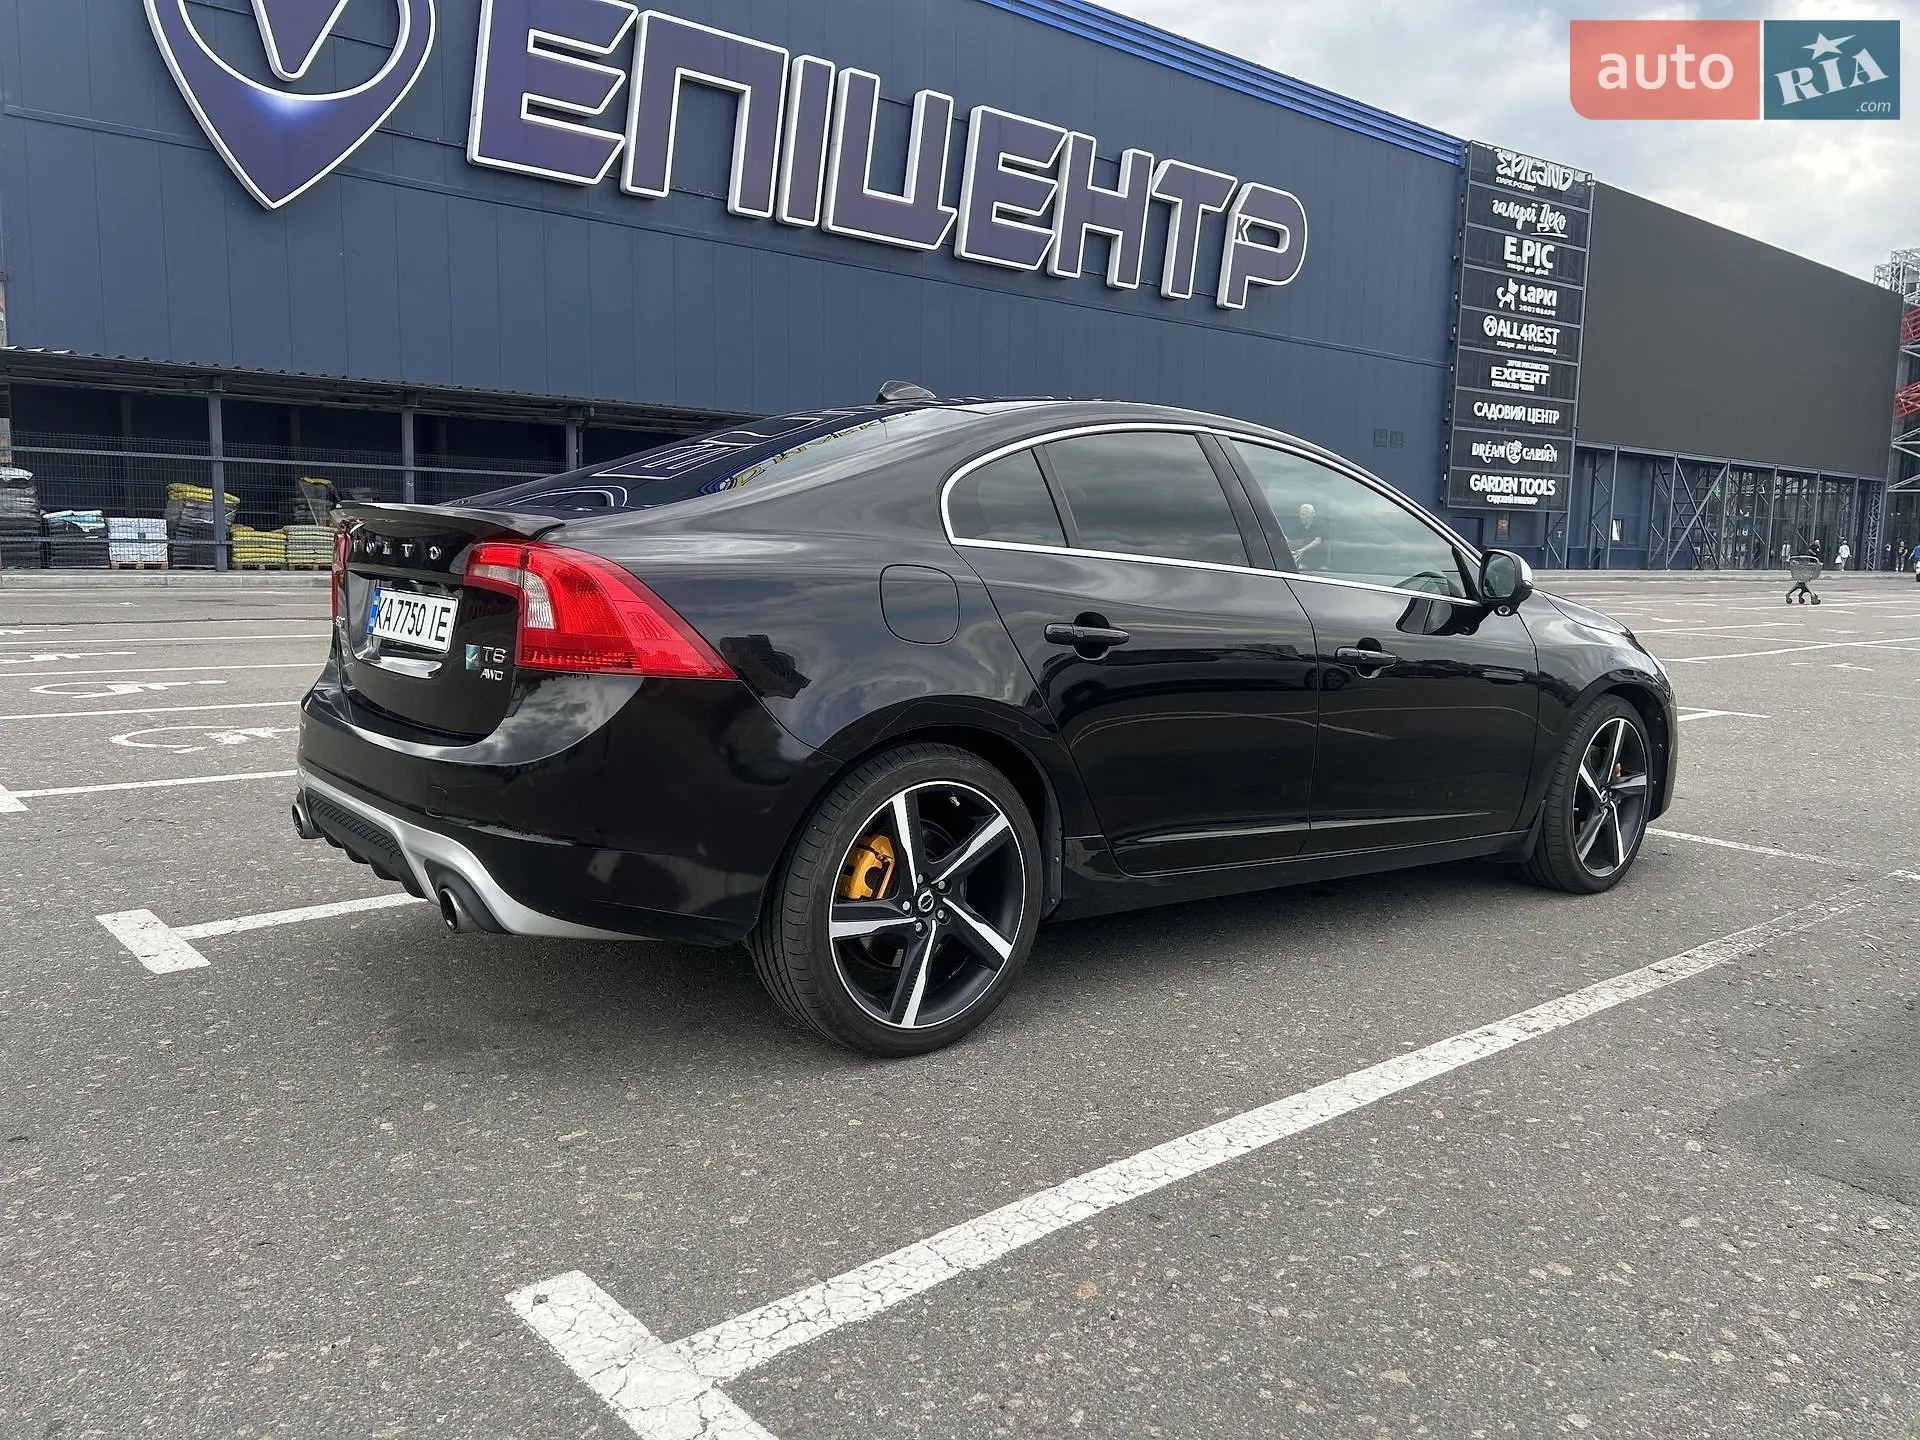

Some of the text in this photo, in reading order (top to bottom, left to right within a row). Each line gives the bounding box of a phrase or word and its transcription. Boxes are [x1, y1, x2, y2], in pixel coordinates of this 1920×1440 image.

[466, 0, 1308, 310] ЕПІЦЕНТР
[1503, 235, 1555, 269] E.PIC
[1497, 319, 1560, 346] ALL4REST
[1490, 366, 1550, 385] EXPERT
[1473, 402, 1560, 424] САДОВИЙ ЦЕНТР
[1522, 443, 1557, 463] GARDEN
[1469, 474, 1556, 496] GARDEN TOOLS
[483, 646, 507, 664] T6
[480, 668, 504, 682] AWD
